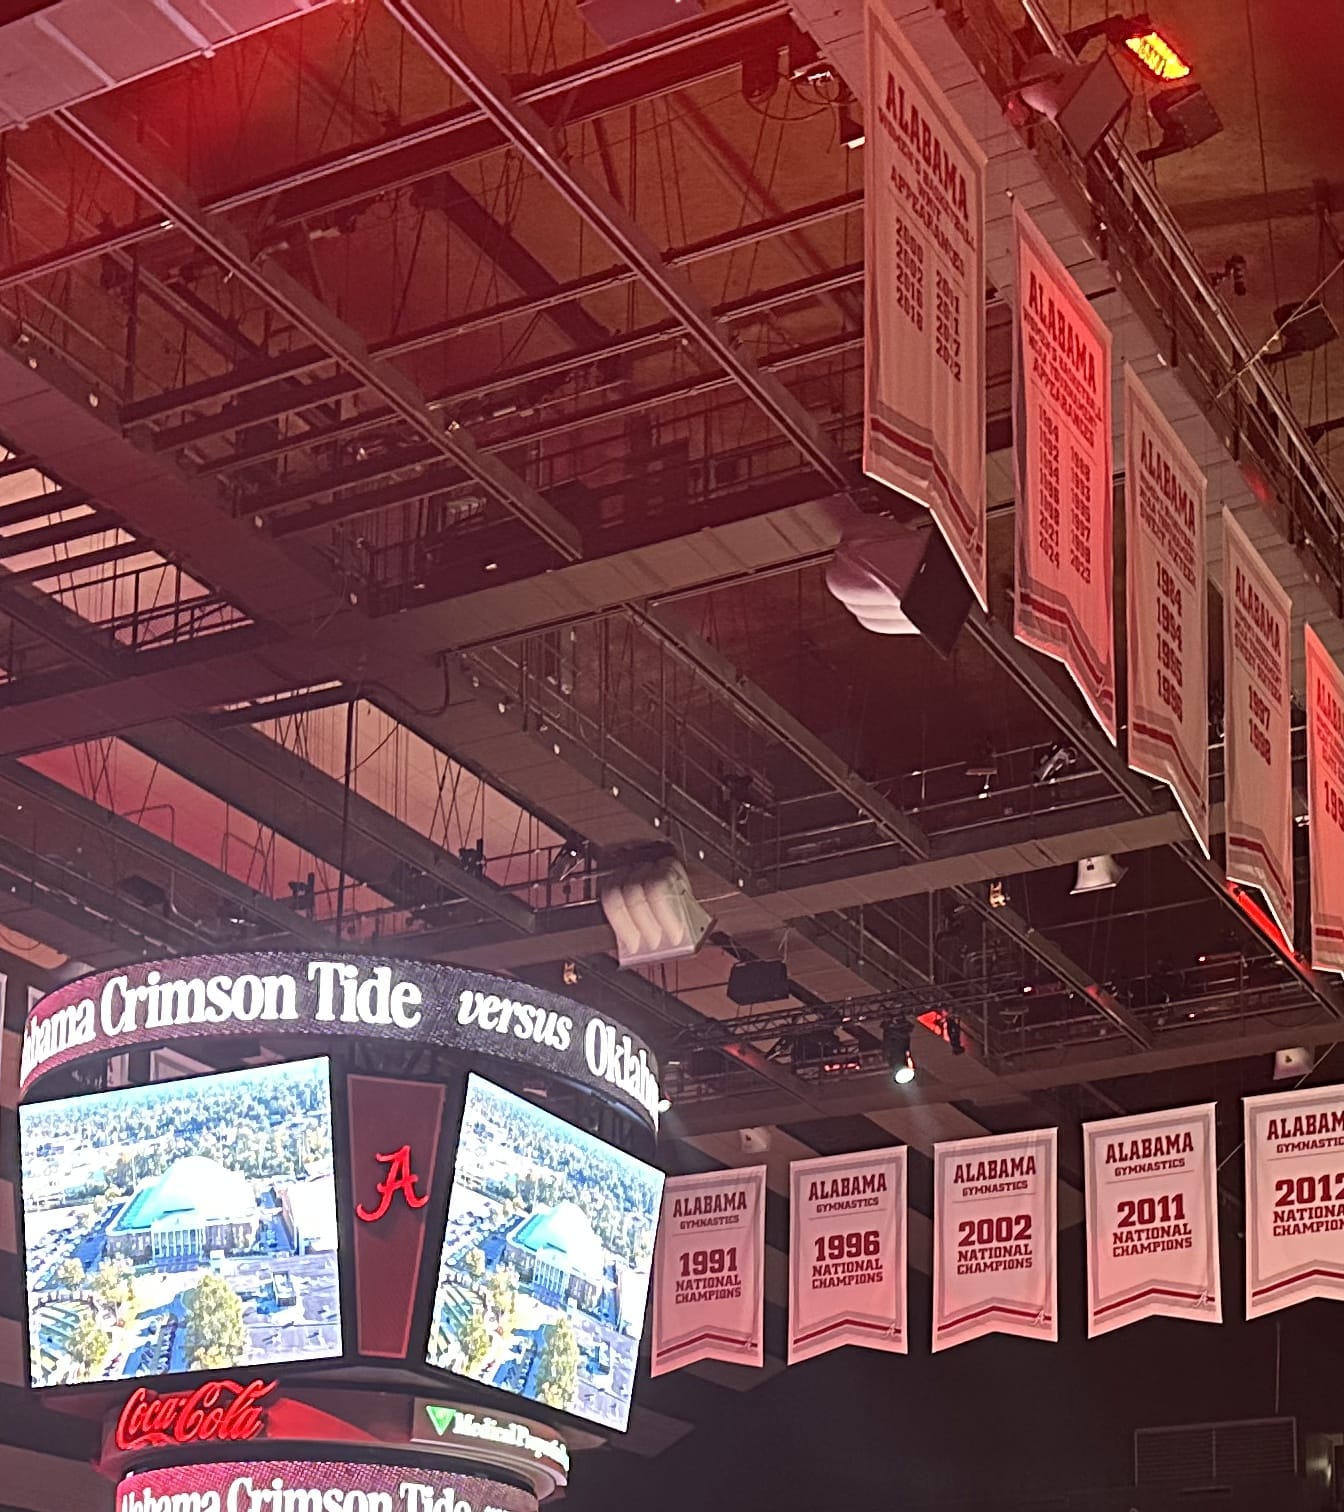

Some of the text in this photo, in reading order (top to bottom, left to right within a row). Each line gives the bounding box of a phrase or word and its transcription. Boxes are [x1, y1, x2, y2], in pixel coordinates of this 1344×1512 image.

[886, 70, 968, 221] ALABAMA
[1029, 271, 1097, 395] ALABAMA
[1140, 431, 1196, 537] ALABAMA
[1235, 565, 1281, 656] ALABAMA
[101, 971, 298, 1036] Crimson
[308, 961, 422, 1028] Tide
[457, 990, 572, 1050] versus
[1106, 1132, 1194, 1164] ALABAMA
[954, 1155, 1037, 1184] ALABAMA
[1115, 1158, 1186, 1177] GYMNASTICS
[809, 1173, 887, 1201] ALABAMA
[963, 1180, 1028, 1197] GYMNASTICS
[673, 1191, 747, 1217] ALABAMA
[816, 1197, 879, 1213] GYMNASTICS
[1117, 1194, 1186, 1227] 2011
[680, 1215, 739, 1229] GYMNASTICS
[958, 1214, 1032, 1246] 2002
[1112, 1223, 1192, 1244] NATIONAL
[814, 1230, 881, 1262] 1996
[957, 1243, 1032, 1262] NATIONAL
[1112, 1237, 1192, 1258] CHAMPIONS
[680, 1247, 737, 1276] 1991
[812, 1258, 883, 1278] NATIONAL
[957, 1257, 1032, 1275] CHAMPIONS
[676, 1275, 741, 1292] NATIONAL
[812, 1271, 883, 1289] CHAMPIONS
[675, 1287, 741, 1304] CHAMPIONS
[115, 1379, 279, 1451] Coca-Cola
